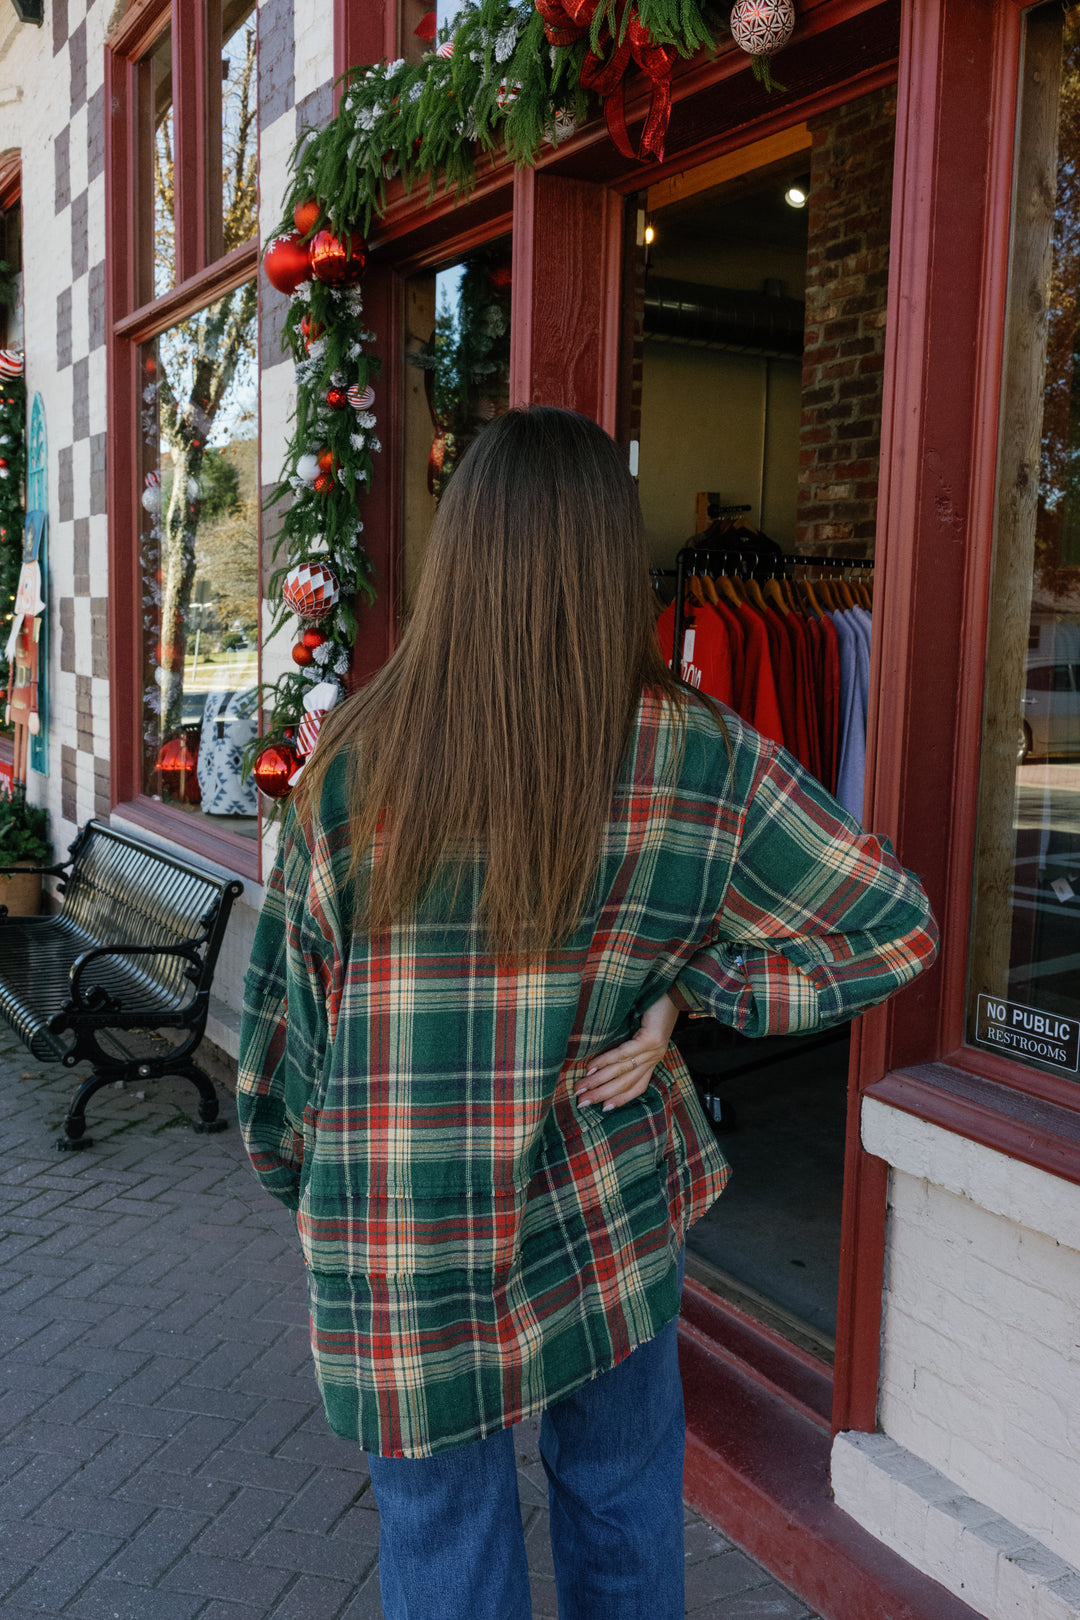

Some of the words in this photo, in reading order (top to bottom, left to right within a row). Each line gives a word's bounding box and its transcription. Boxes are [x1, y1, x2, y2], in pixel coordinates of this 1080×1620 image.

[986, 1001, 1007, 1021] NO
[1012, 1009, 1071, 1041] PUBLIC
[987, 1026, 1067, 1062] RESTROOMS
